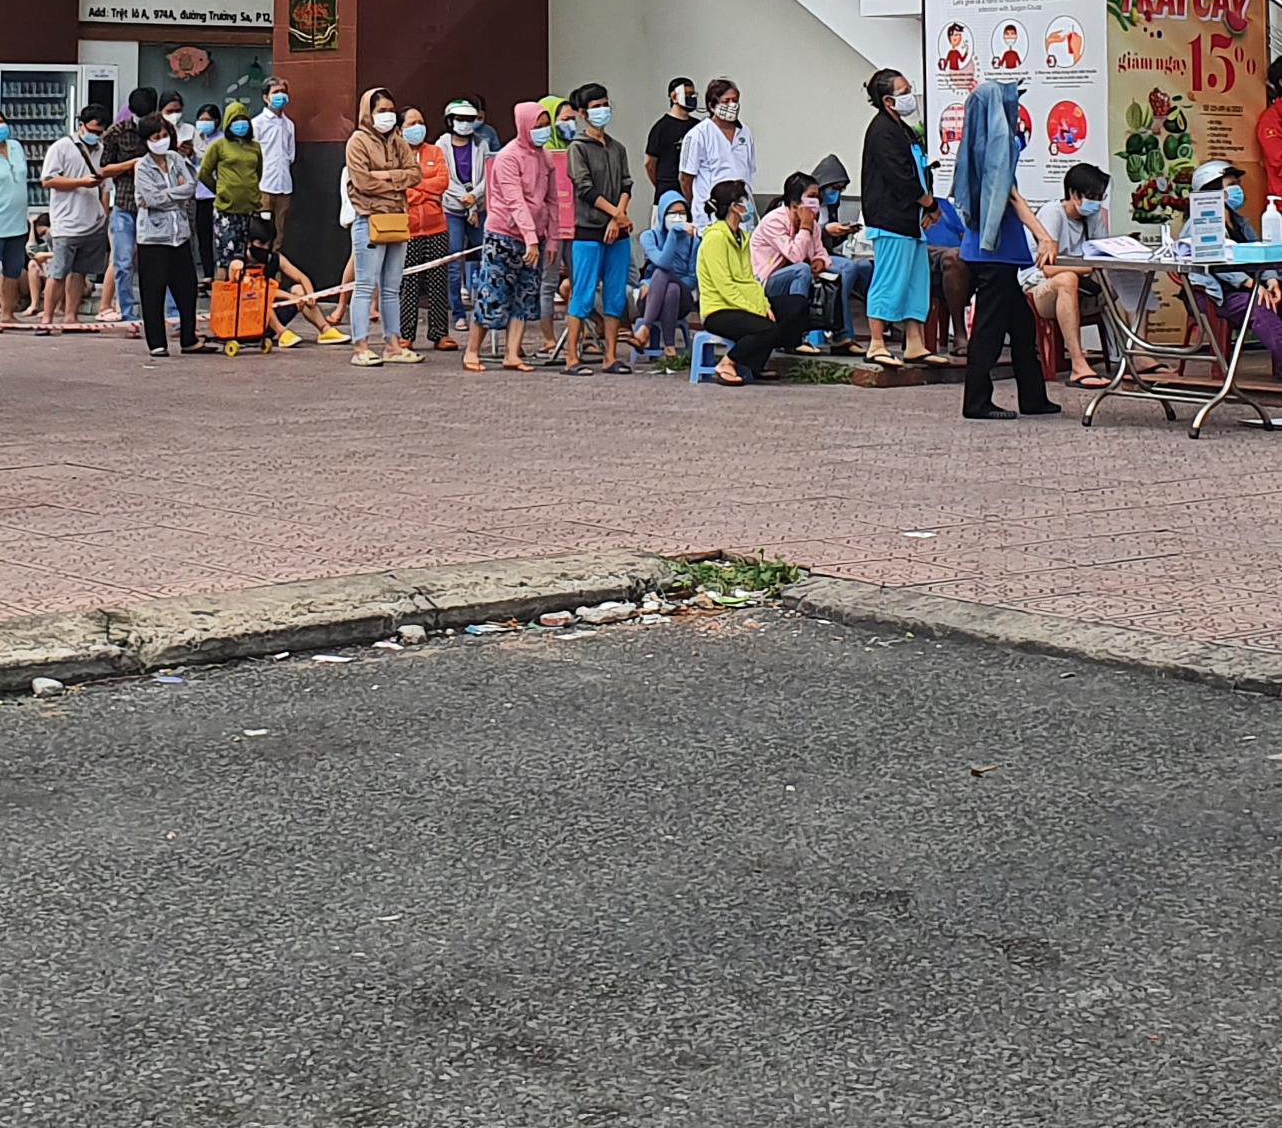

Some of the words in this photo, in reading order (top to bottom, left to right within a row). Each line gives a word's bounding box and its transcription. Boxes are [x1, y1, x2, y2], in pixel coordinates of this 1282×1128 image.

[88, 8, 109, 18] Add:
[111, 8, 128, 21] Trệt
[180, 9, 206, 23] đường
[208, 9, 237, 23] Trường
[1156, 55, 1187, 76] ngay
